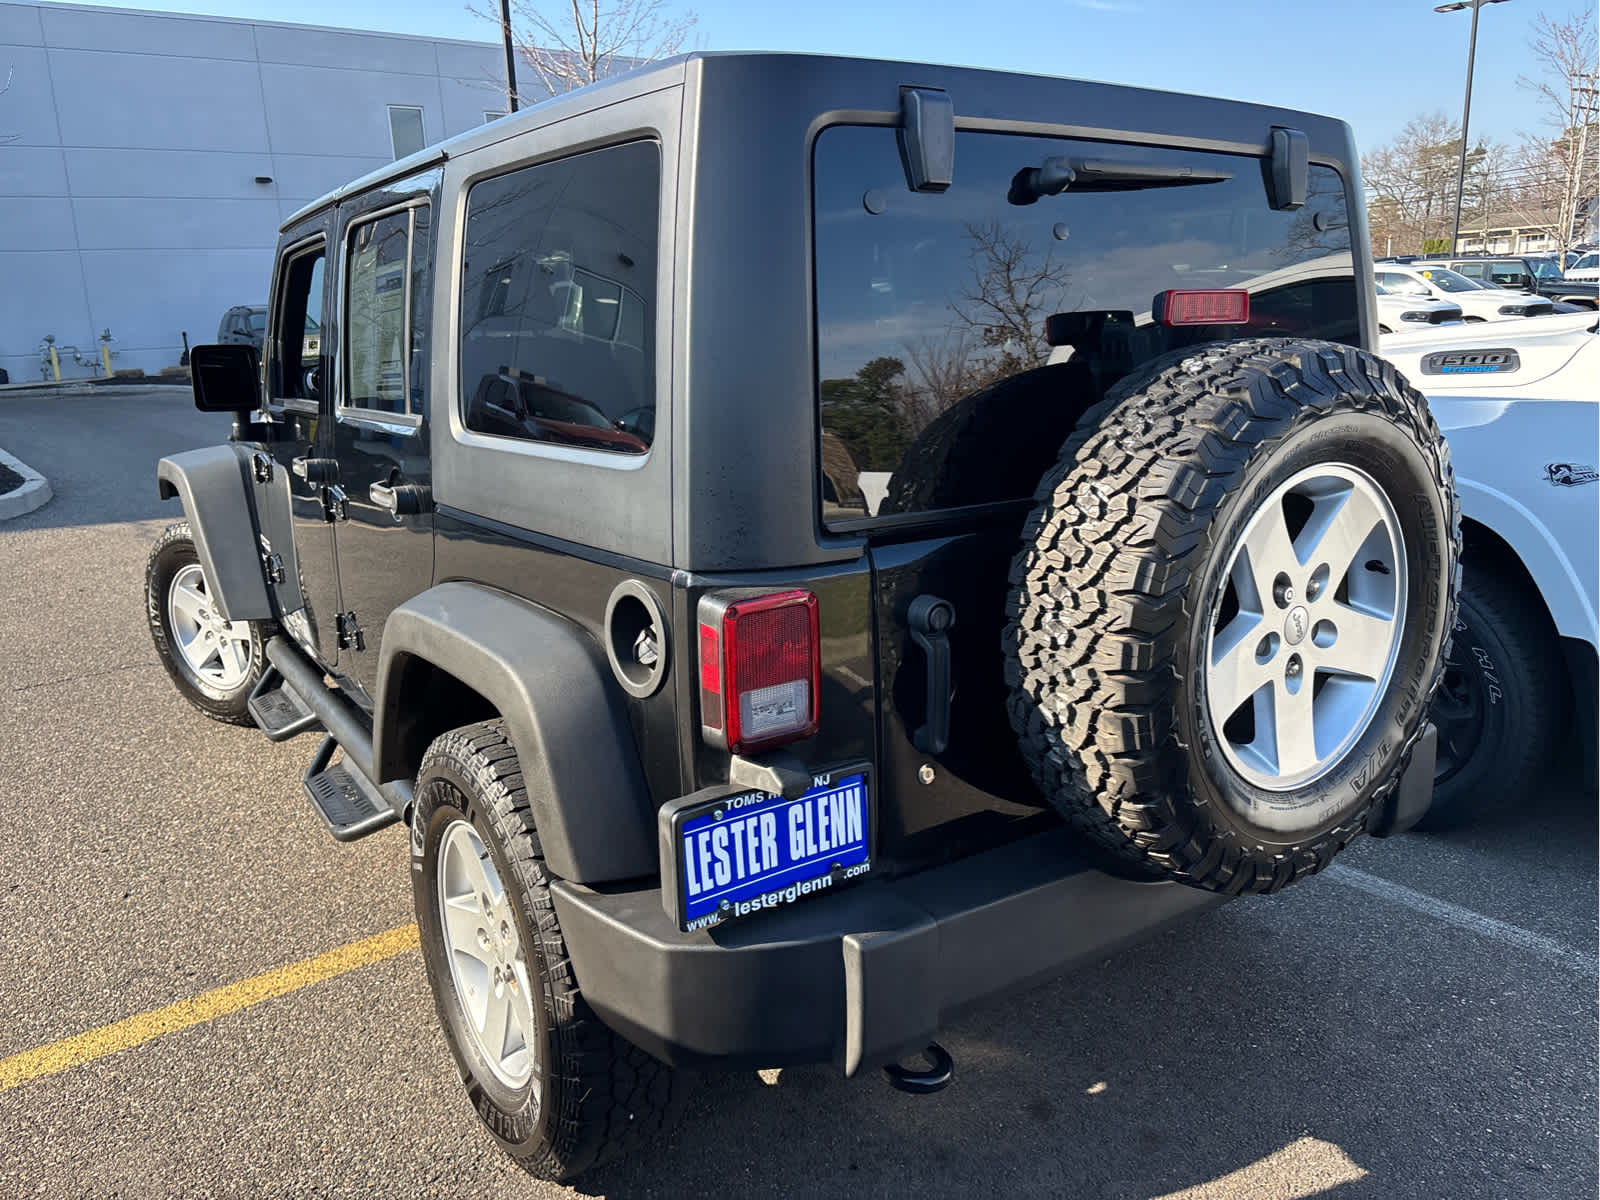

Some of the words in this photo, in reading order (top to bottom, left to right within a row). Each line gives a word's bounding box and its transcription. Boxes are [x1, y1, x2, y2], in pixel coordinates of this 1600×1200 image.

[1433, 353, 1509, 367] 1500
[726, 792, 764, 811] TOMS
[814, 774, 830, 787] NJ
[684, 812, 778, 897] LESTER
[788, 787, 862, 861] GLENN
[735, 875, 832, 917] lesterglenn
